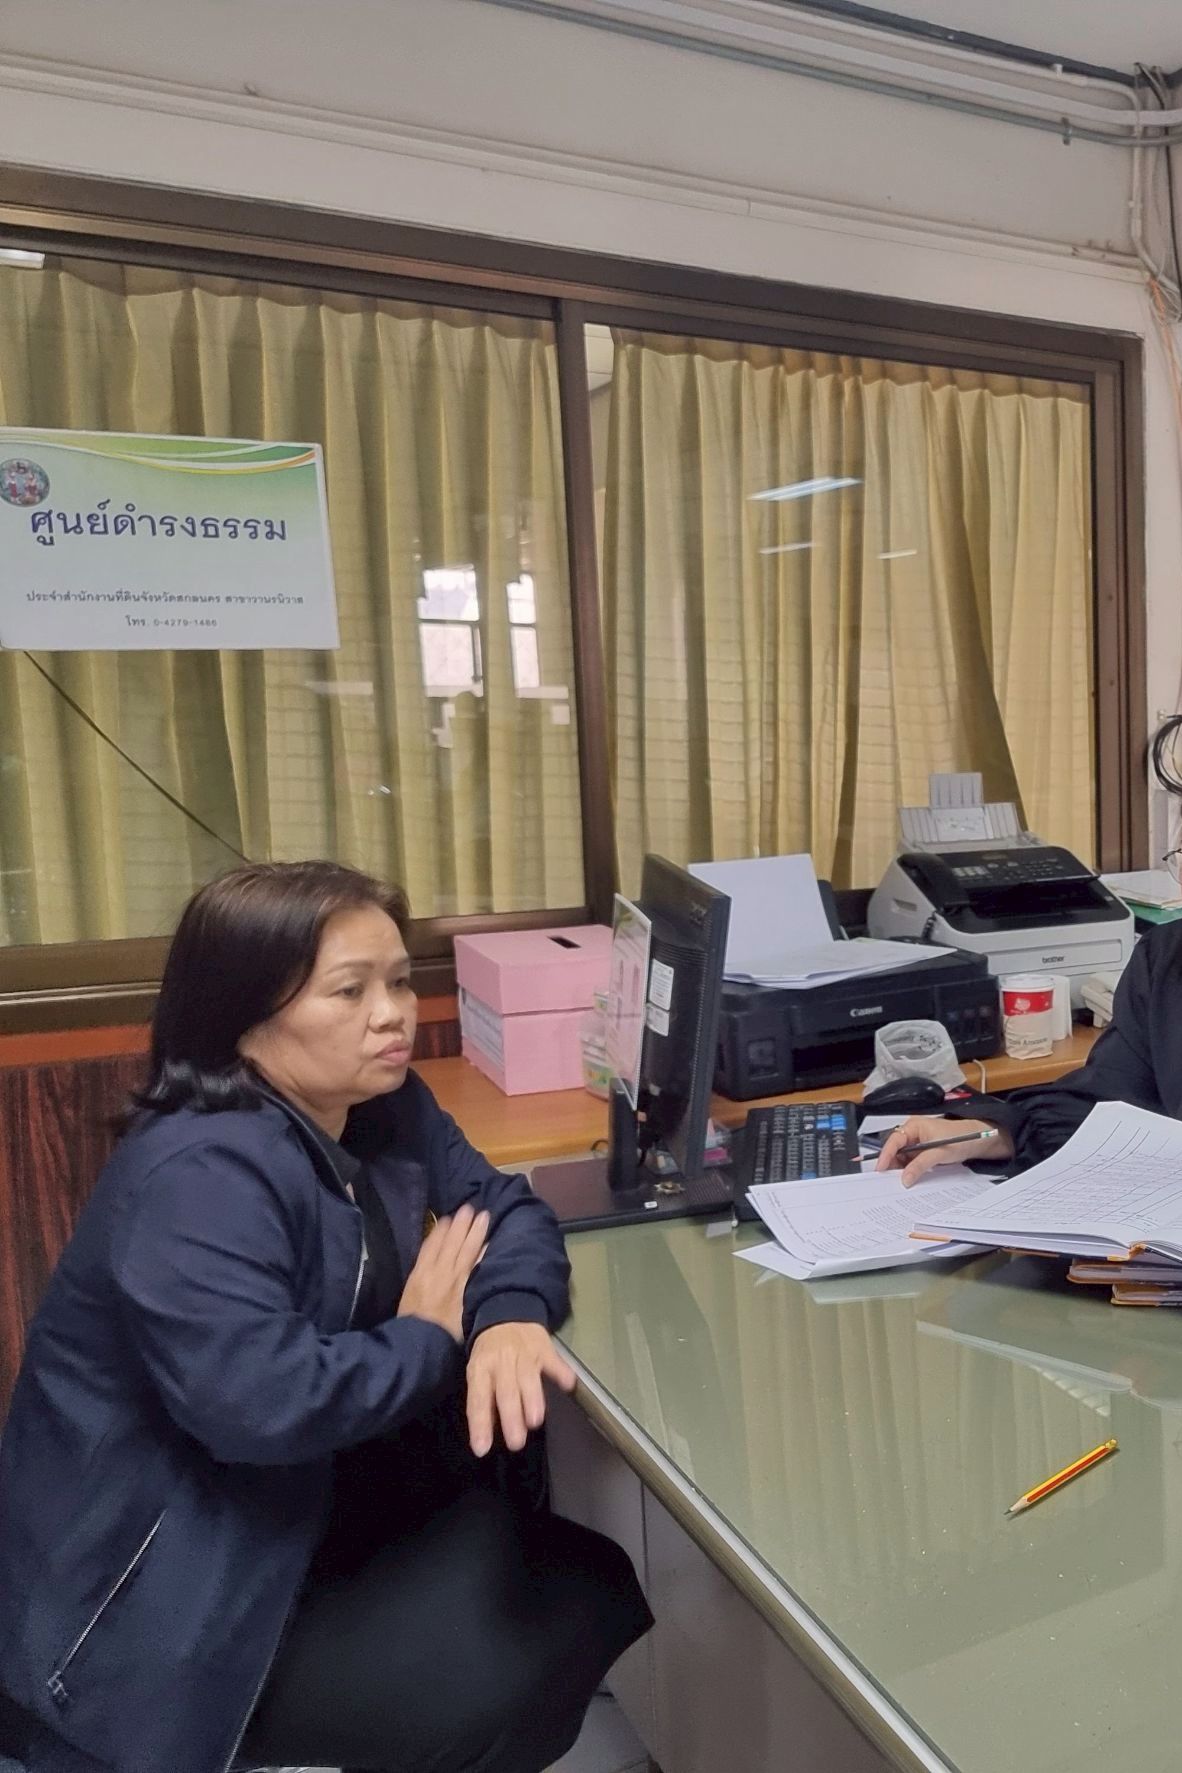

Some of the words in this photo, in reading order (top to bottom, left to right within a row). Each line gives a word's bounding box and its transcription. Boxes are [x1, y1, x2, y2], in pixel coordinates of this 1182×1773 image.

[30, 498, 288, 546] ศูนย์ดำรงธรรม
